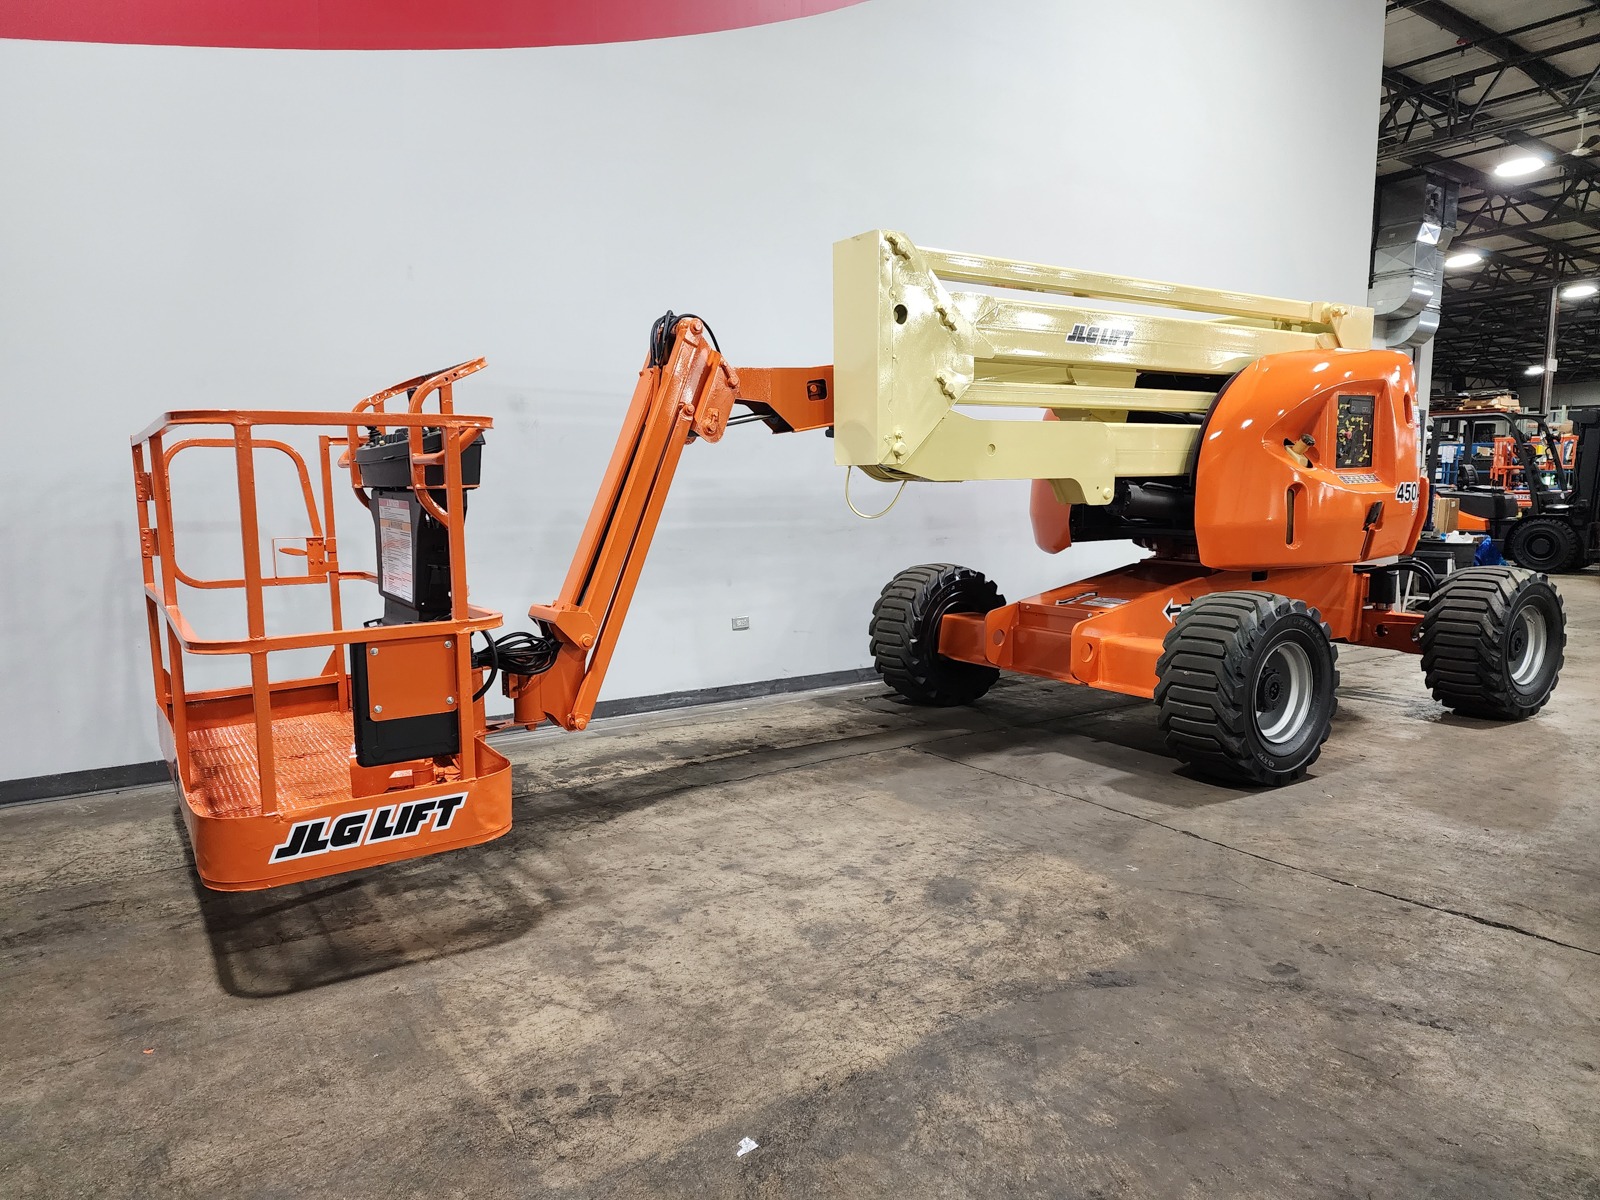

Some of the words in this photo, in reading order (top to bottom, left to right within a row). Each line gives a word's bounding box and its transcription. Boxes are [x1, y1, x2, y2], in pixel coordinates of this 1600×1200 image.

[1067, 325, 1100, 343] JLG
[1100, 328, 1134, 346] LIFT
[1397, 483, 1419, 502] 450
[274, 814, 368, 859] JLG
[369, 796, 463, 840] LIFT
